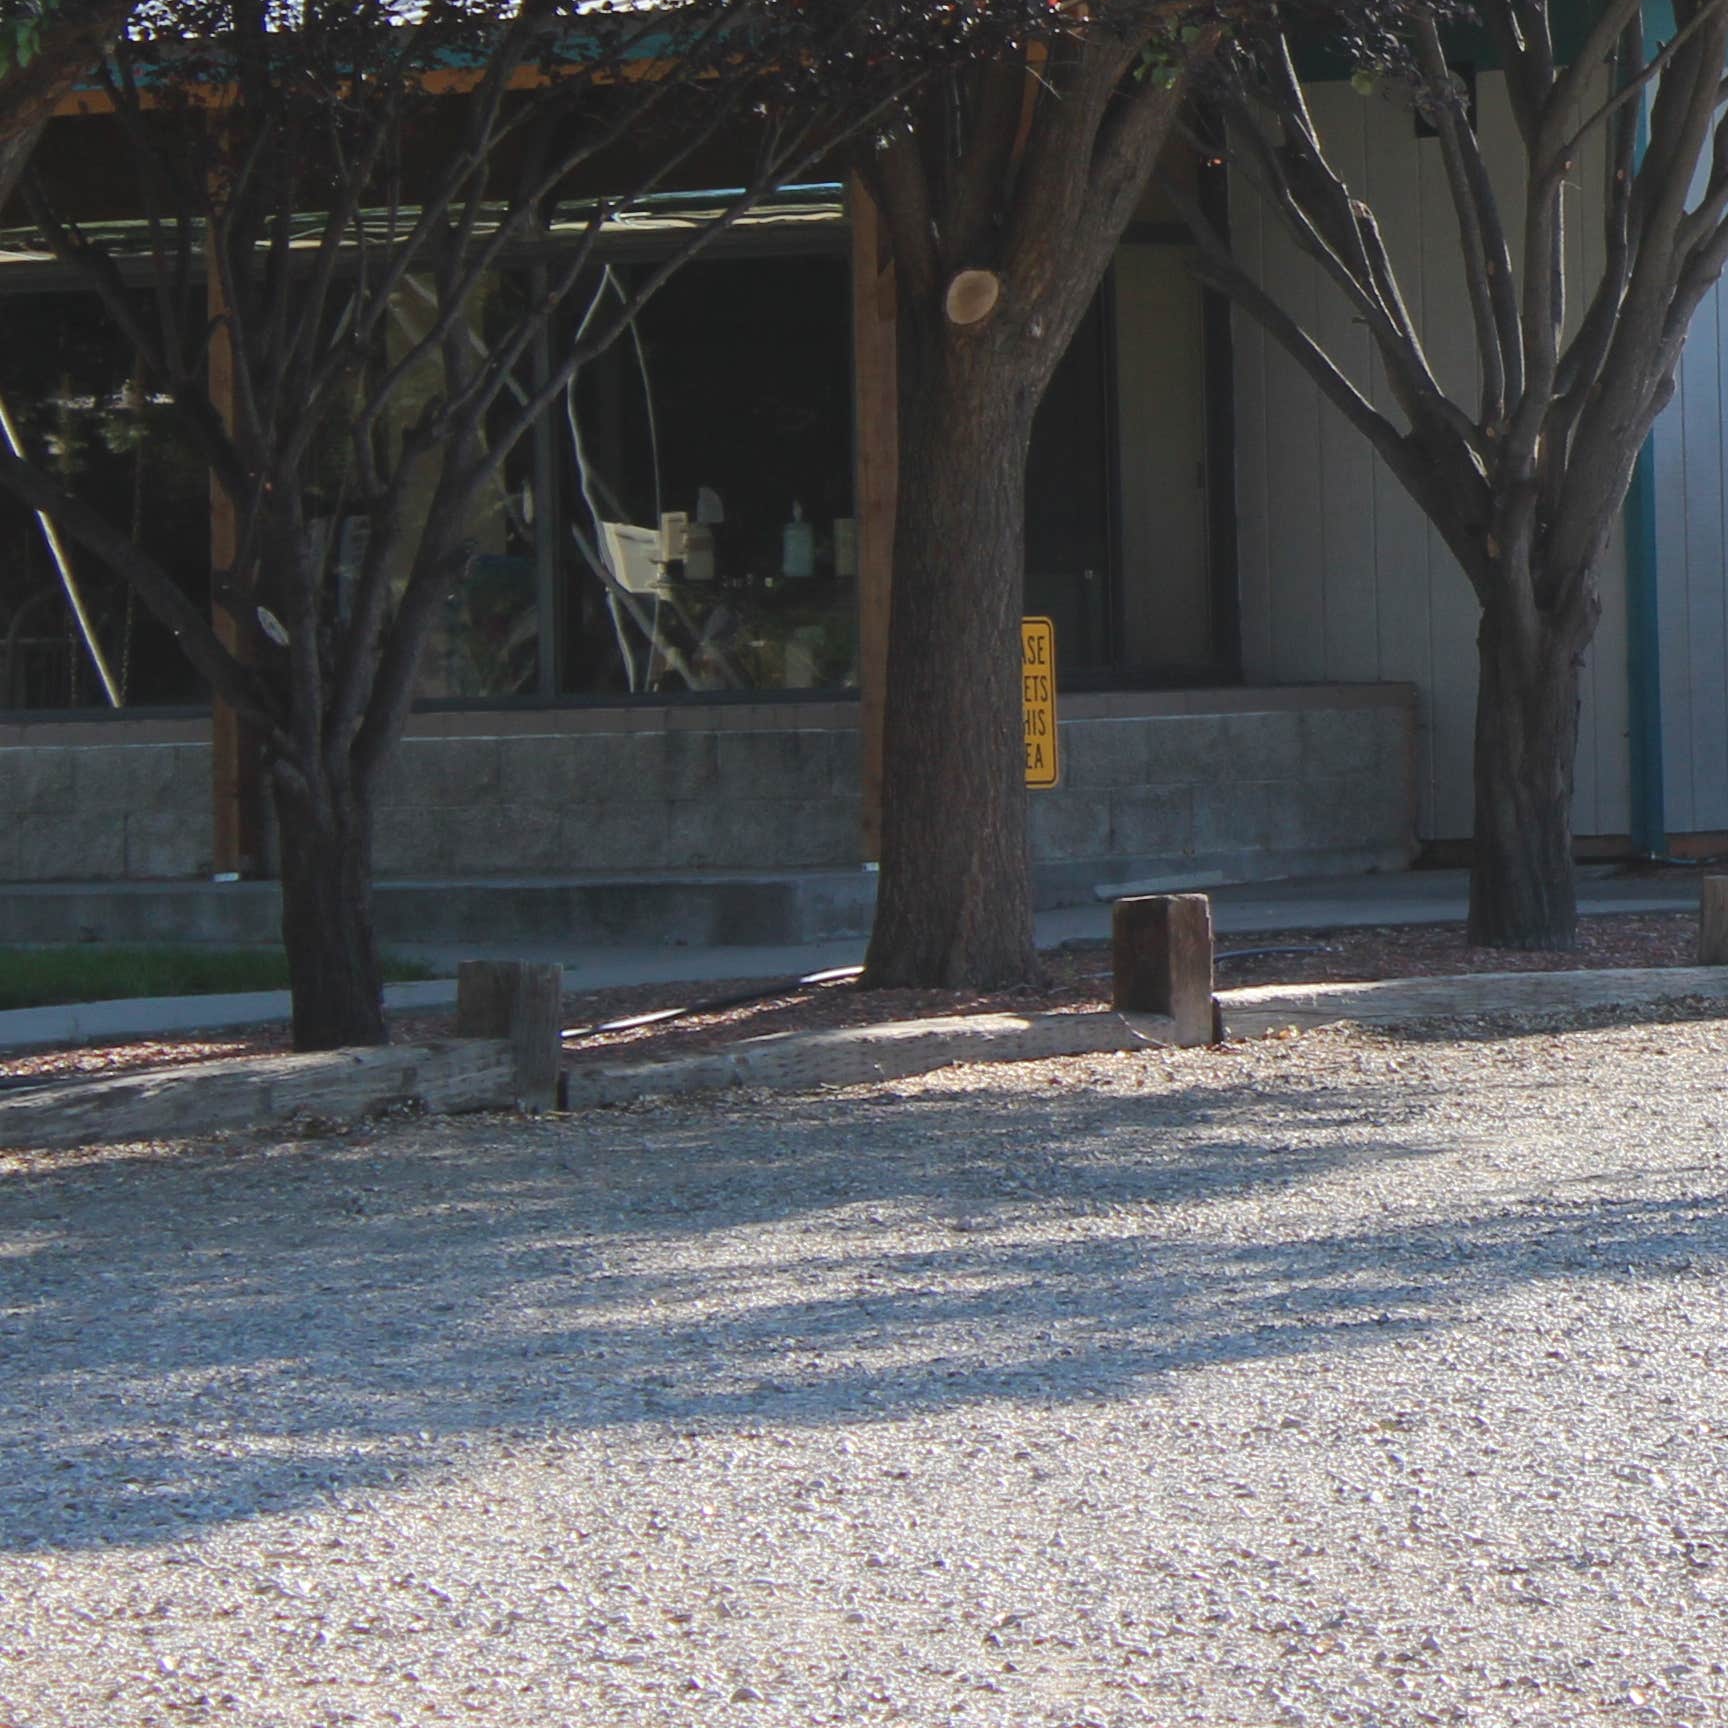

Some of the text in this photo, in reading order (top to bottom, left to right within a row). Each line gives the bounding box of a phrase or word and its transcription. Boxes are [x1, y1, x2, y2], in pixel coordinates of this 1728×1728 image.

[1024, 675, 1048, 702] ETS
[1024, 709, 1046, 737] HIS
[1026, 743, 1044, 769] EA
